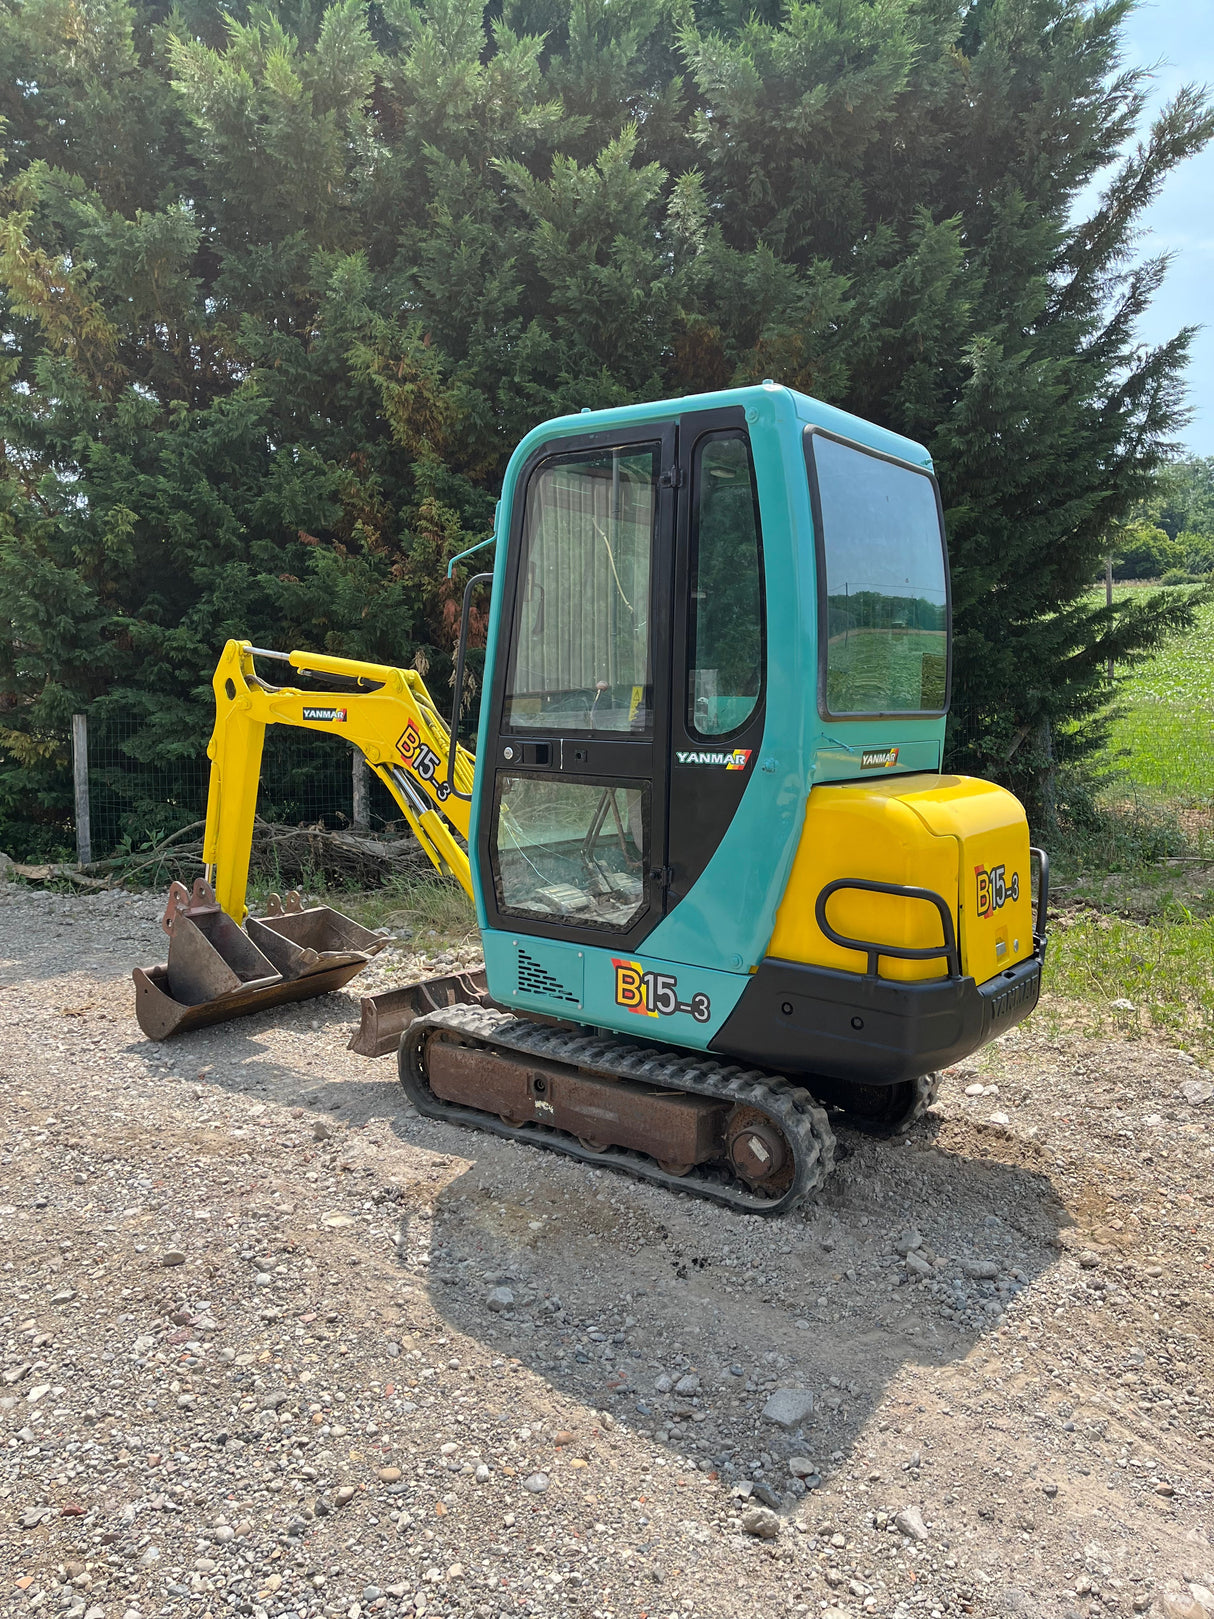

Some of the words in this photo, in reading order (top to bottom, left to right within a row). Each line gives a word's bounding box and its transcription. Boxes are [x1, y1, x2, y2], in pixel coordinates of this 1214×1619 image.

[303, 708, 344, 719] YANMAR
[396, 724, 451, 802] B15-3
[676, 751, 746, 765] YANMAR
[862, 752, 896, 765] YANMAR
[977, 864, 1019, 917] B15-3
[615, 965, 711, 1023] B15-3
